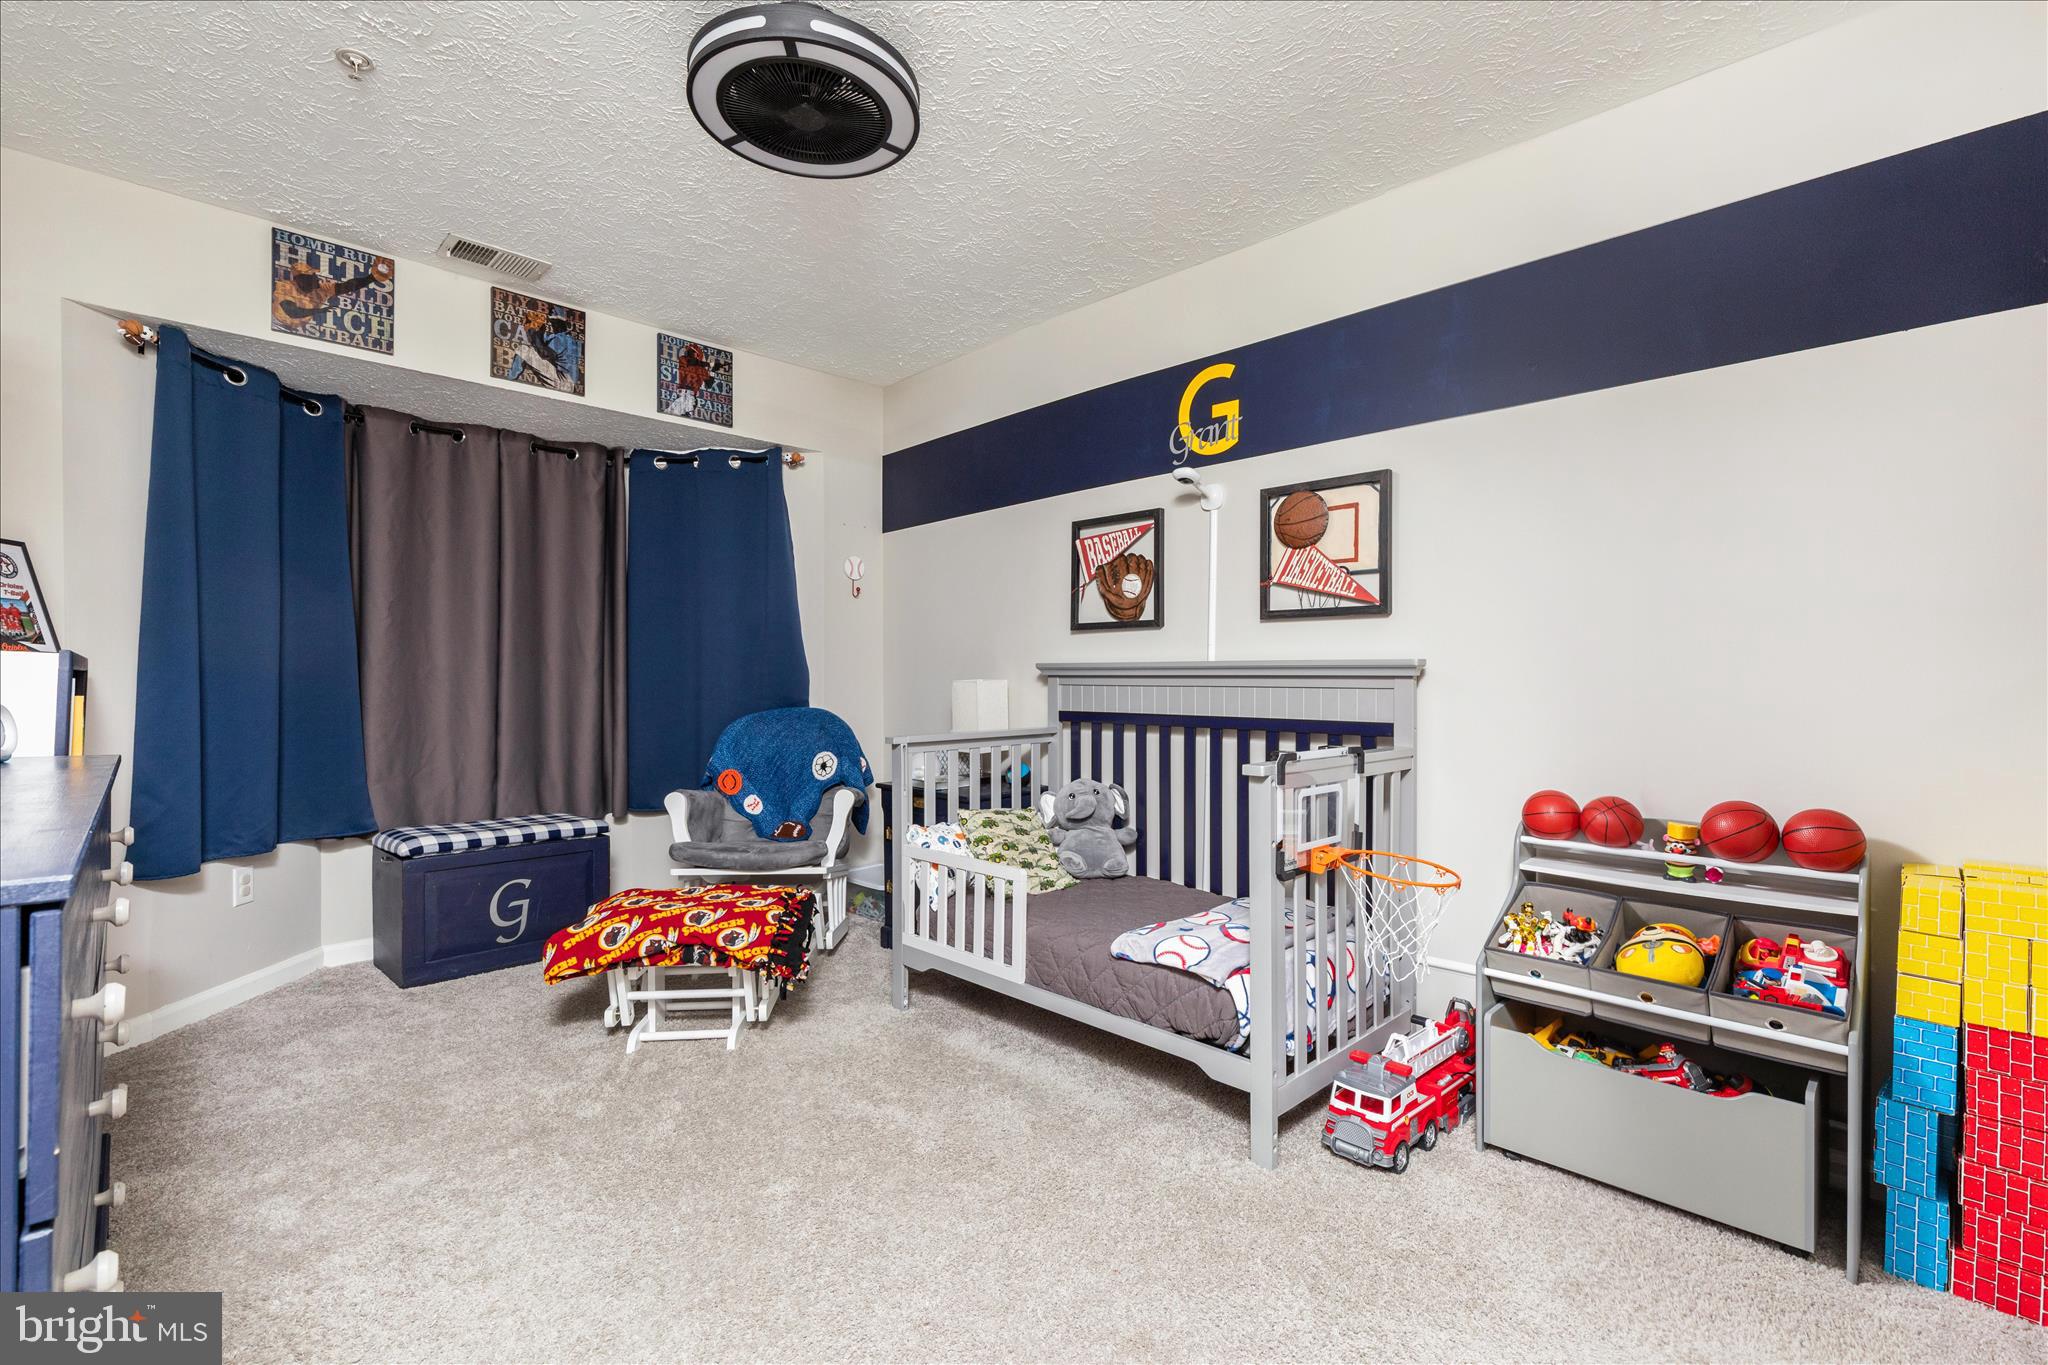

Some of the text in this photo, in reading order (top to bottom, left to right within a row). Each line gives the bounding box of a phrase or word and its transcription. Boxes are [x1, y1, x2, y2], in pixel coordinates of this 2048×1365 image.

[275, 229, 336, 255] HOME
[338, 296, 394, 320] BALL
[495, 289, 584, 323] FLY BLL
[296, 321, 394, 353] STBALL
[660, 365, 732, 395] STKE
[697, 398, 732, 414] PARK
[703, 391, 731, 404] BASE
[1178, 363, 1240, 456] G
[1169, 413, 1244, 466] Grant
[1084, 526, 1142, 575] BASEBALL
[1281, 547, 1358, 598] BASKETBALL
[489, 878, 532, 944] G
